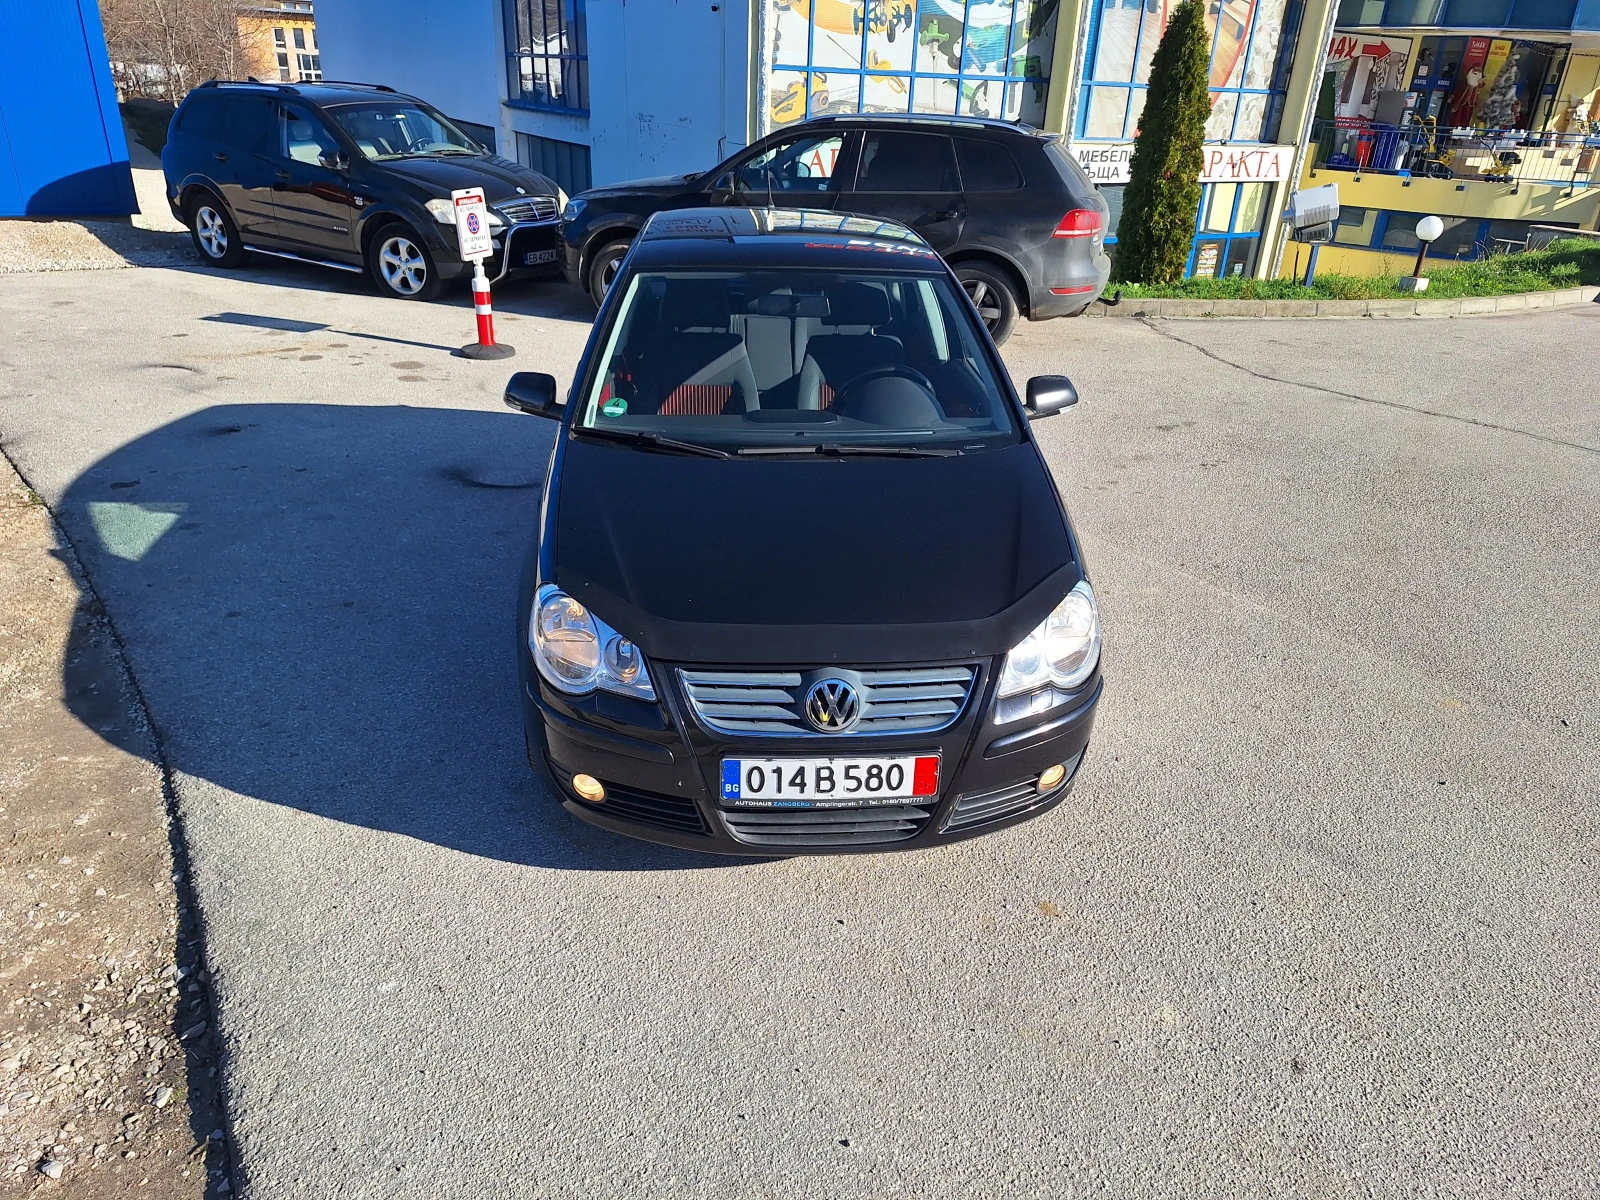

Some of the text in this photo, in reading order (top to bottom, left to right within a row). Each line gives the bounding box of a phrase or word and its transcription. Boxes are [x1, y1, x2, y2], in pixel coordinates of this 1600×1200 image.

[1086, 166, 1120, 180] ЪЩА
[539, 251, 554, 262] 4224
[724, 783, 739, 793] BG
